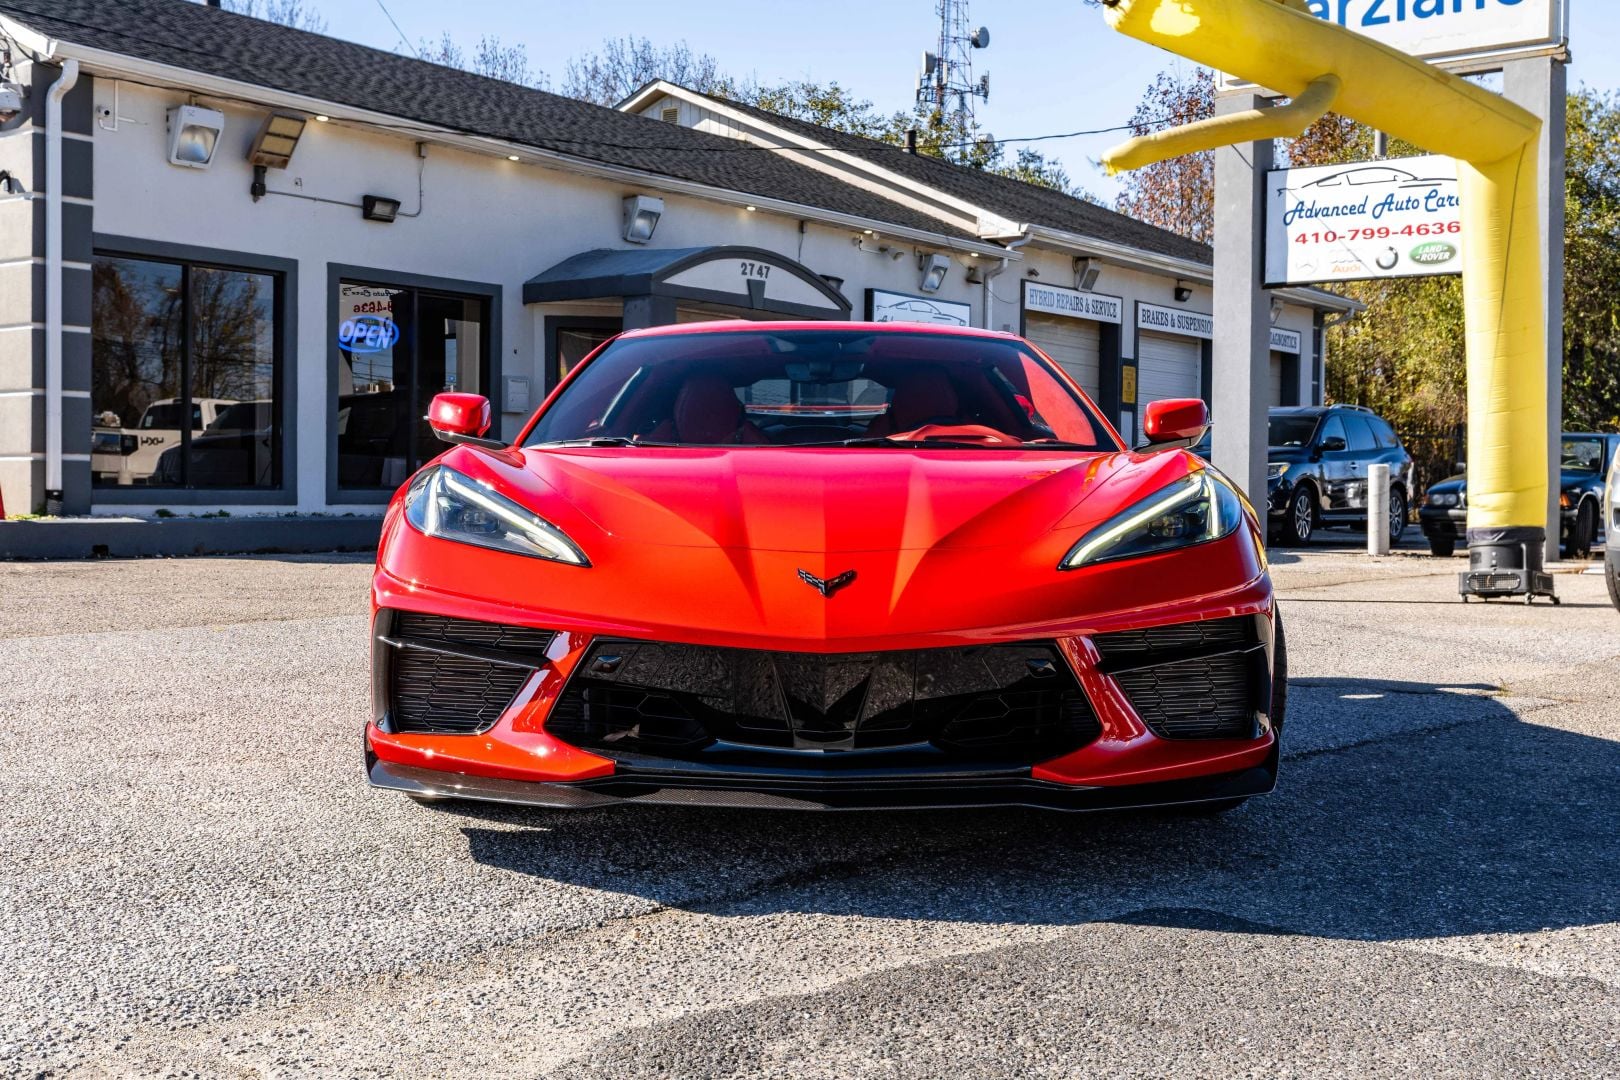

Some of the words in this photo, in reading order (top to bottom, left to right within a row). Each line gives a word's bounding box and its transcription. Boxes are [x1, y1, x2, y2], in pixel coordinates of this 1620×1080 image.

[1283, 195, 1369, 226] Advanced
[1372, 193, 1420, 219] Auto
[1295, 221, 1461, 244] 410-799-4636
[741, 262, 770, 279] 2747
[1332, 264, 1361, 274] Audi
[1029, 288, 1055, 308] HYBRID
[1056, 293, 1084, 313] REPAIRS
[1085, 297, 1090, 314] &
[1091, 299, 1117, 318] SERVICE
[1141, 308, 1169, 327] BRAKES
[1170, 313, 1176, 328] &
[1177, 314, 1213, 334] SUSPENSIO
[339, 320, 393, 349] OPEN
